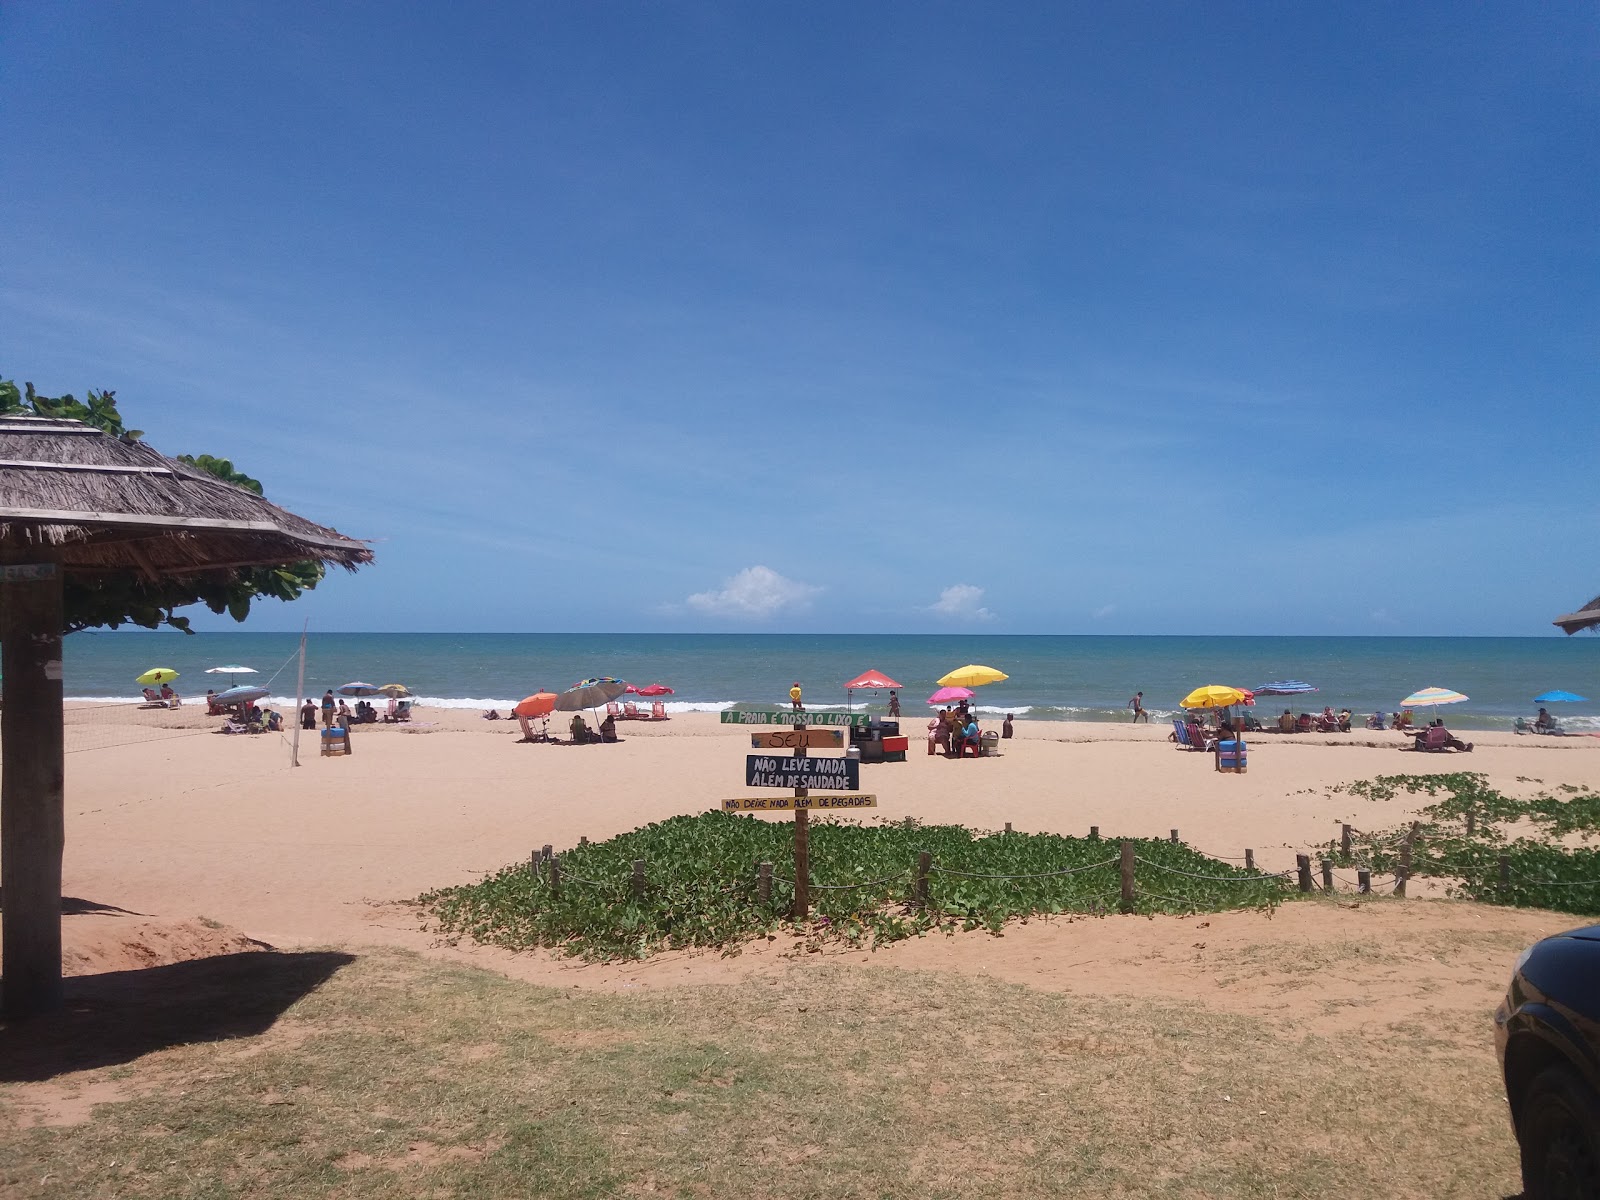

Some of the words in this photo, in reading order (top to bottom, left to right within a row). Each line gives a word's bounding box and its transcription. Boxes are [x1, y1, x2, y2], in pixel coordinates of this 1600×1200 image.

[726, 712, 733, 722] A
[738, 712, 766, 724] PRAIA
[771, 712, 777, 724] É
[816, 715, 823, 725] O
[828, 715, 852, 725] LIXO
[769, 732, 809, 747] SEU
[754, 757, 776, 772] NÃO
[782, 759, 810, 772] LEVE
[816, 759, 846, 775] NADA
[752, 772, 784, 786] ALÉM
[788, 775, 799, 788] DE
[801, 775, 850, 790] SAUDADE
[726, 799, 739, 808] NÃO
[770, 799, 788, 808] NADA
[794, 796, 812, 807] ALÉM
[819, 798, 829, 806] DE
[832, 797, 871, 806] PEGADAS
